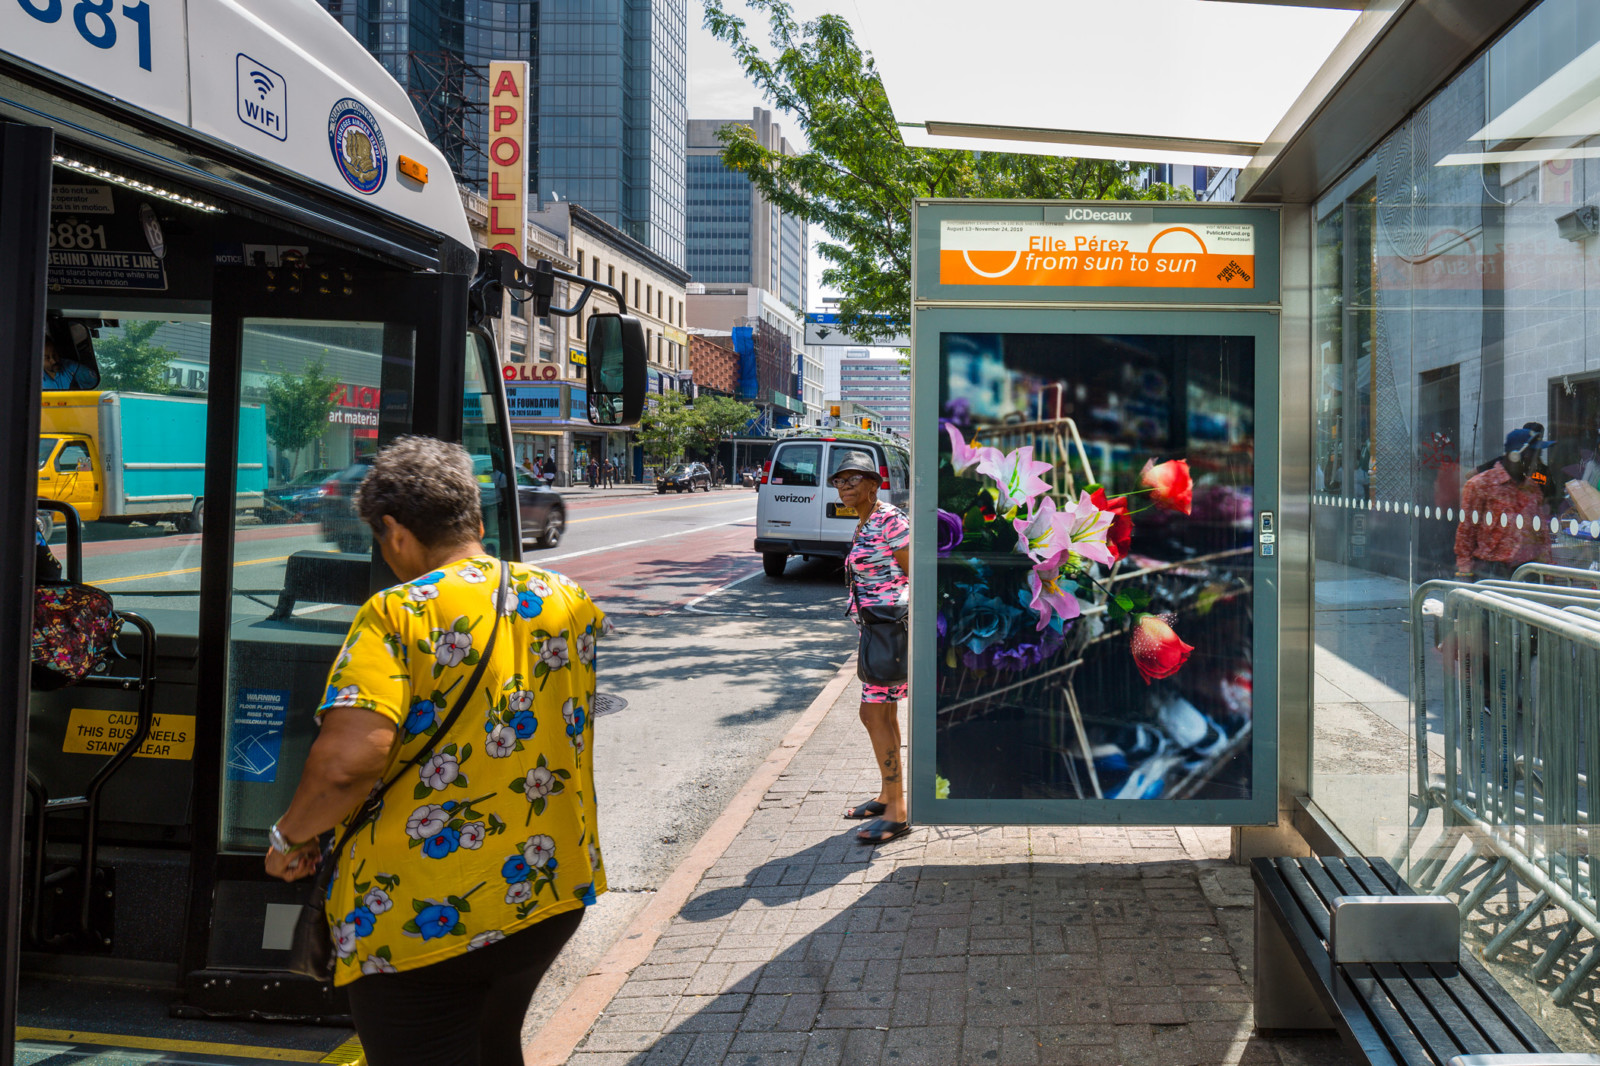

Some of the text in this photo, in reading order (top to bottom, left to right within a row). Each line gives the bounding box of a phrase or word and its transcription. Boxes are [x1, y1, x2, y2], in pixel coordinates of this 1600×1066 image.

[244, 99, 280, 131] WIFI
[330, 101, 350, 125] QUALITY
[336, 118, 352, 145] TUSKEGEE
[1065, 208, 1132, 221] JCDecaux
[1029, 235, 1129, 252] Elle Pérez
[91, 253, 129, 267] WHITE
[132, 255, 160, 268] LINE
[216, 255, 243, 263] NOTICE
[1026, 253, 1197, 273] from sun to sun
[126, 271, 145, 279] white
[1216, 260, 1237, 281] PUBLIC
[1224, 269, 1238, 283] ART
[1235, 264, 1251, 282] FUND
[164, 366, 209, 391] PUB
[502, 365, 557, 380] OLLO
[517, 398, 559, 409] FOUNDATION
[329, 410, 380, 426] art material
[774, 493, 811, 503] verizon
[246, 694, 281, 702] WARNING
[107, 713, 161, 727] CAUTN
[77, 724, 187, 743] THIS BUS NEELS
